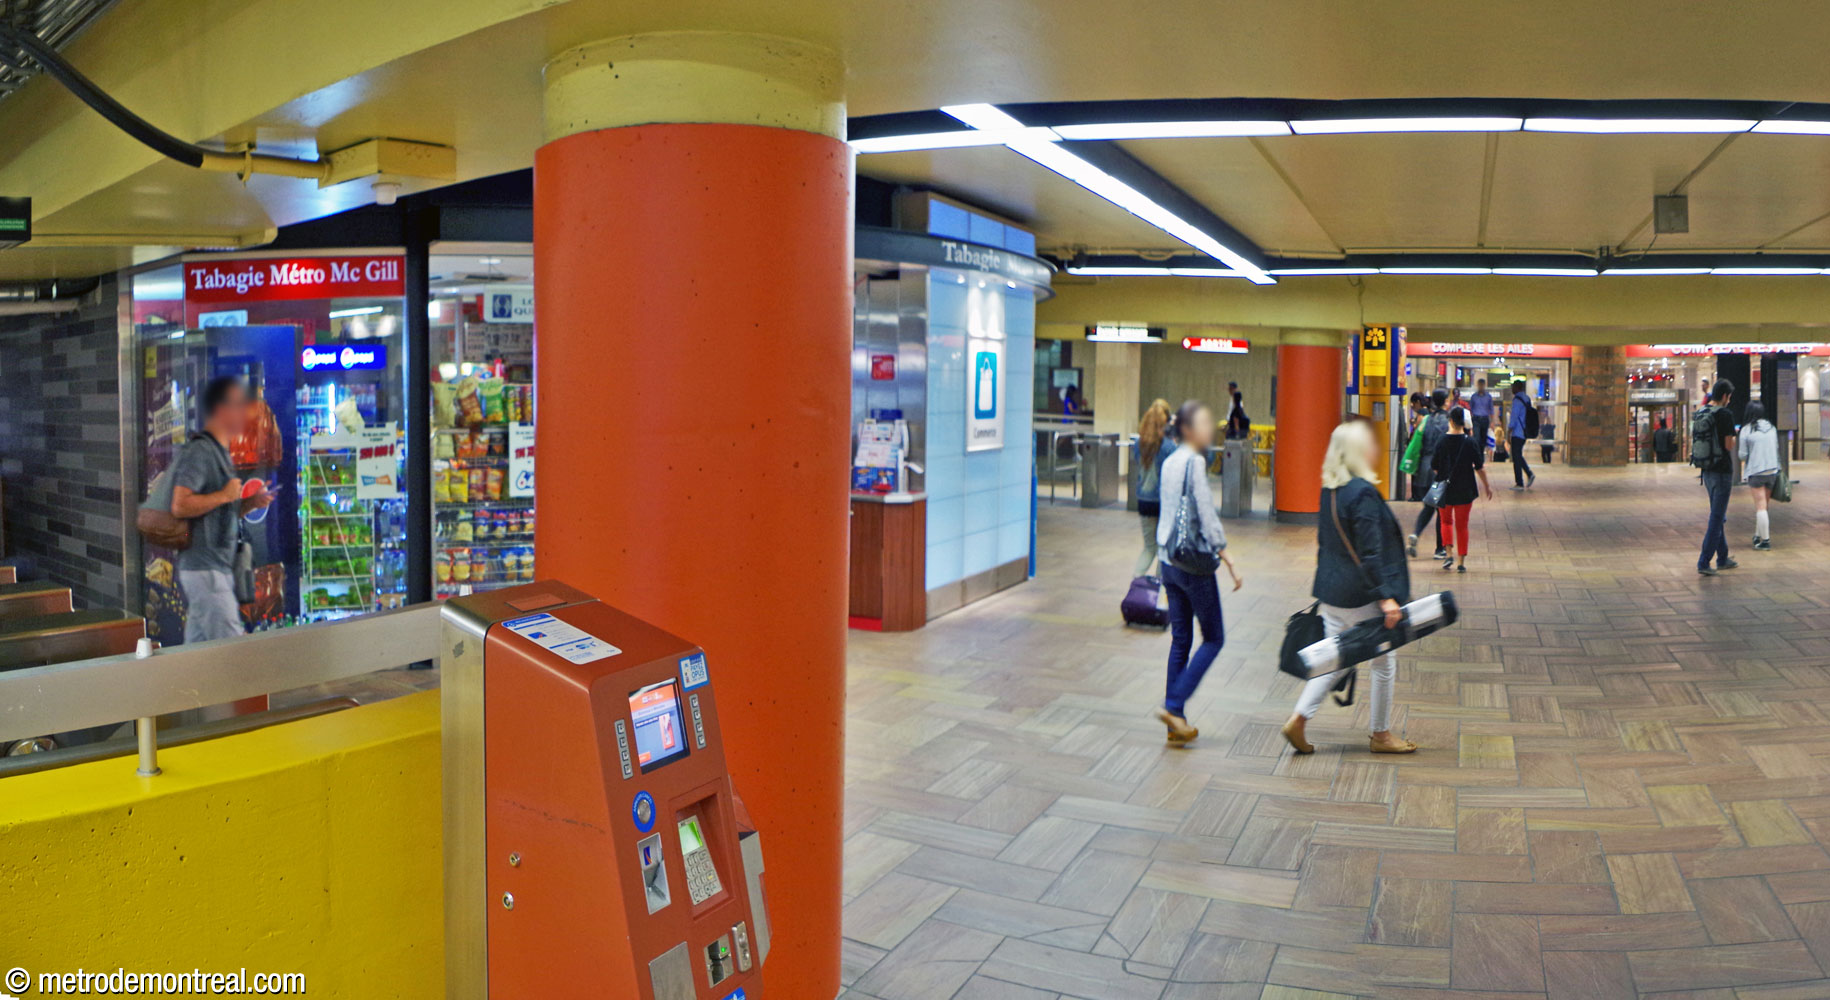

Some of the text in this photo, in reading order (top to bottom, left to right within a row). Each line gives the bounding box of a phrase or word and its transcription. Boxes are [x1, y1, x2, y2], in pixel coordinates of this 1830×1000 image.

[941, 241, 1001, 272] Tabagie
[191, 260, 399, 294] Tabagie Métro Mc Gill
[1432, 342, 1534, 354] COMPLEXE LES AILES
